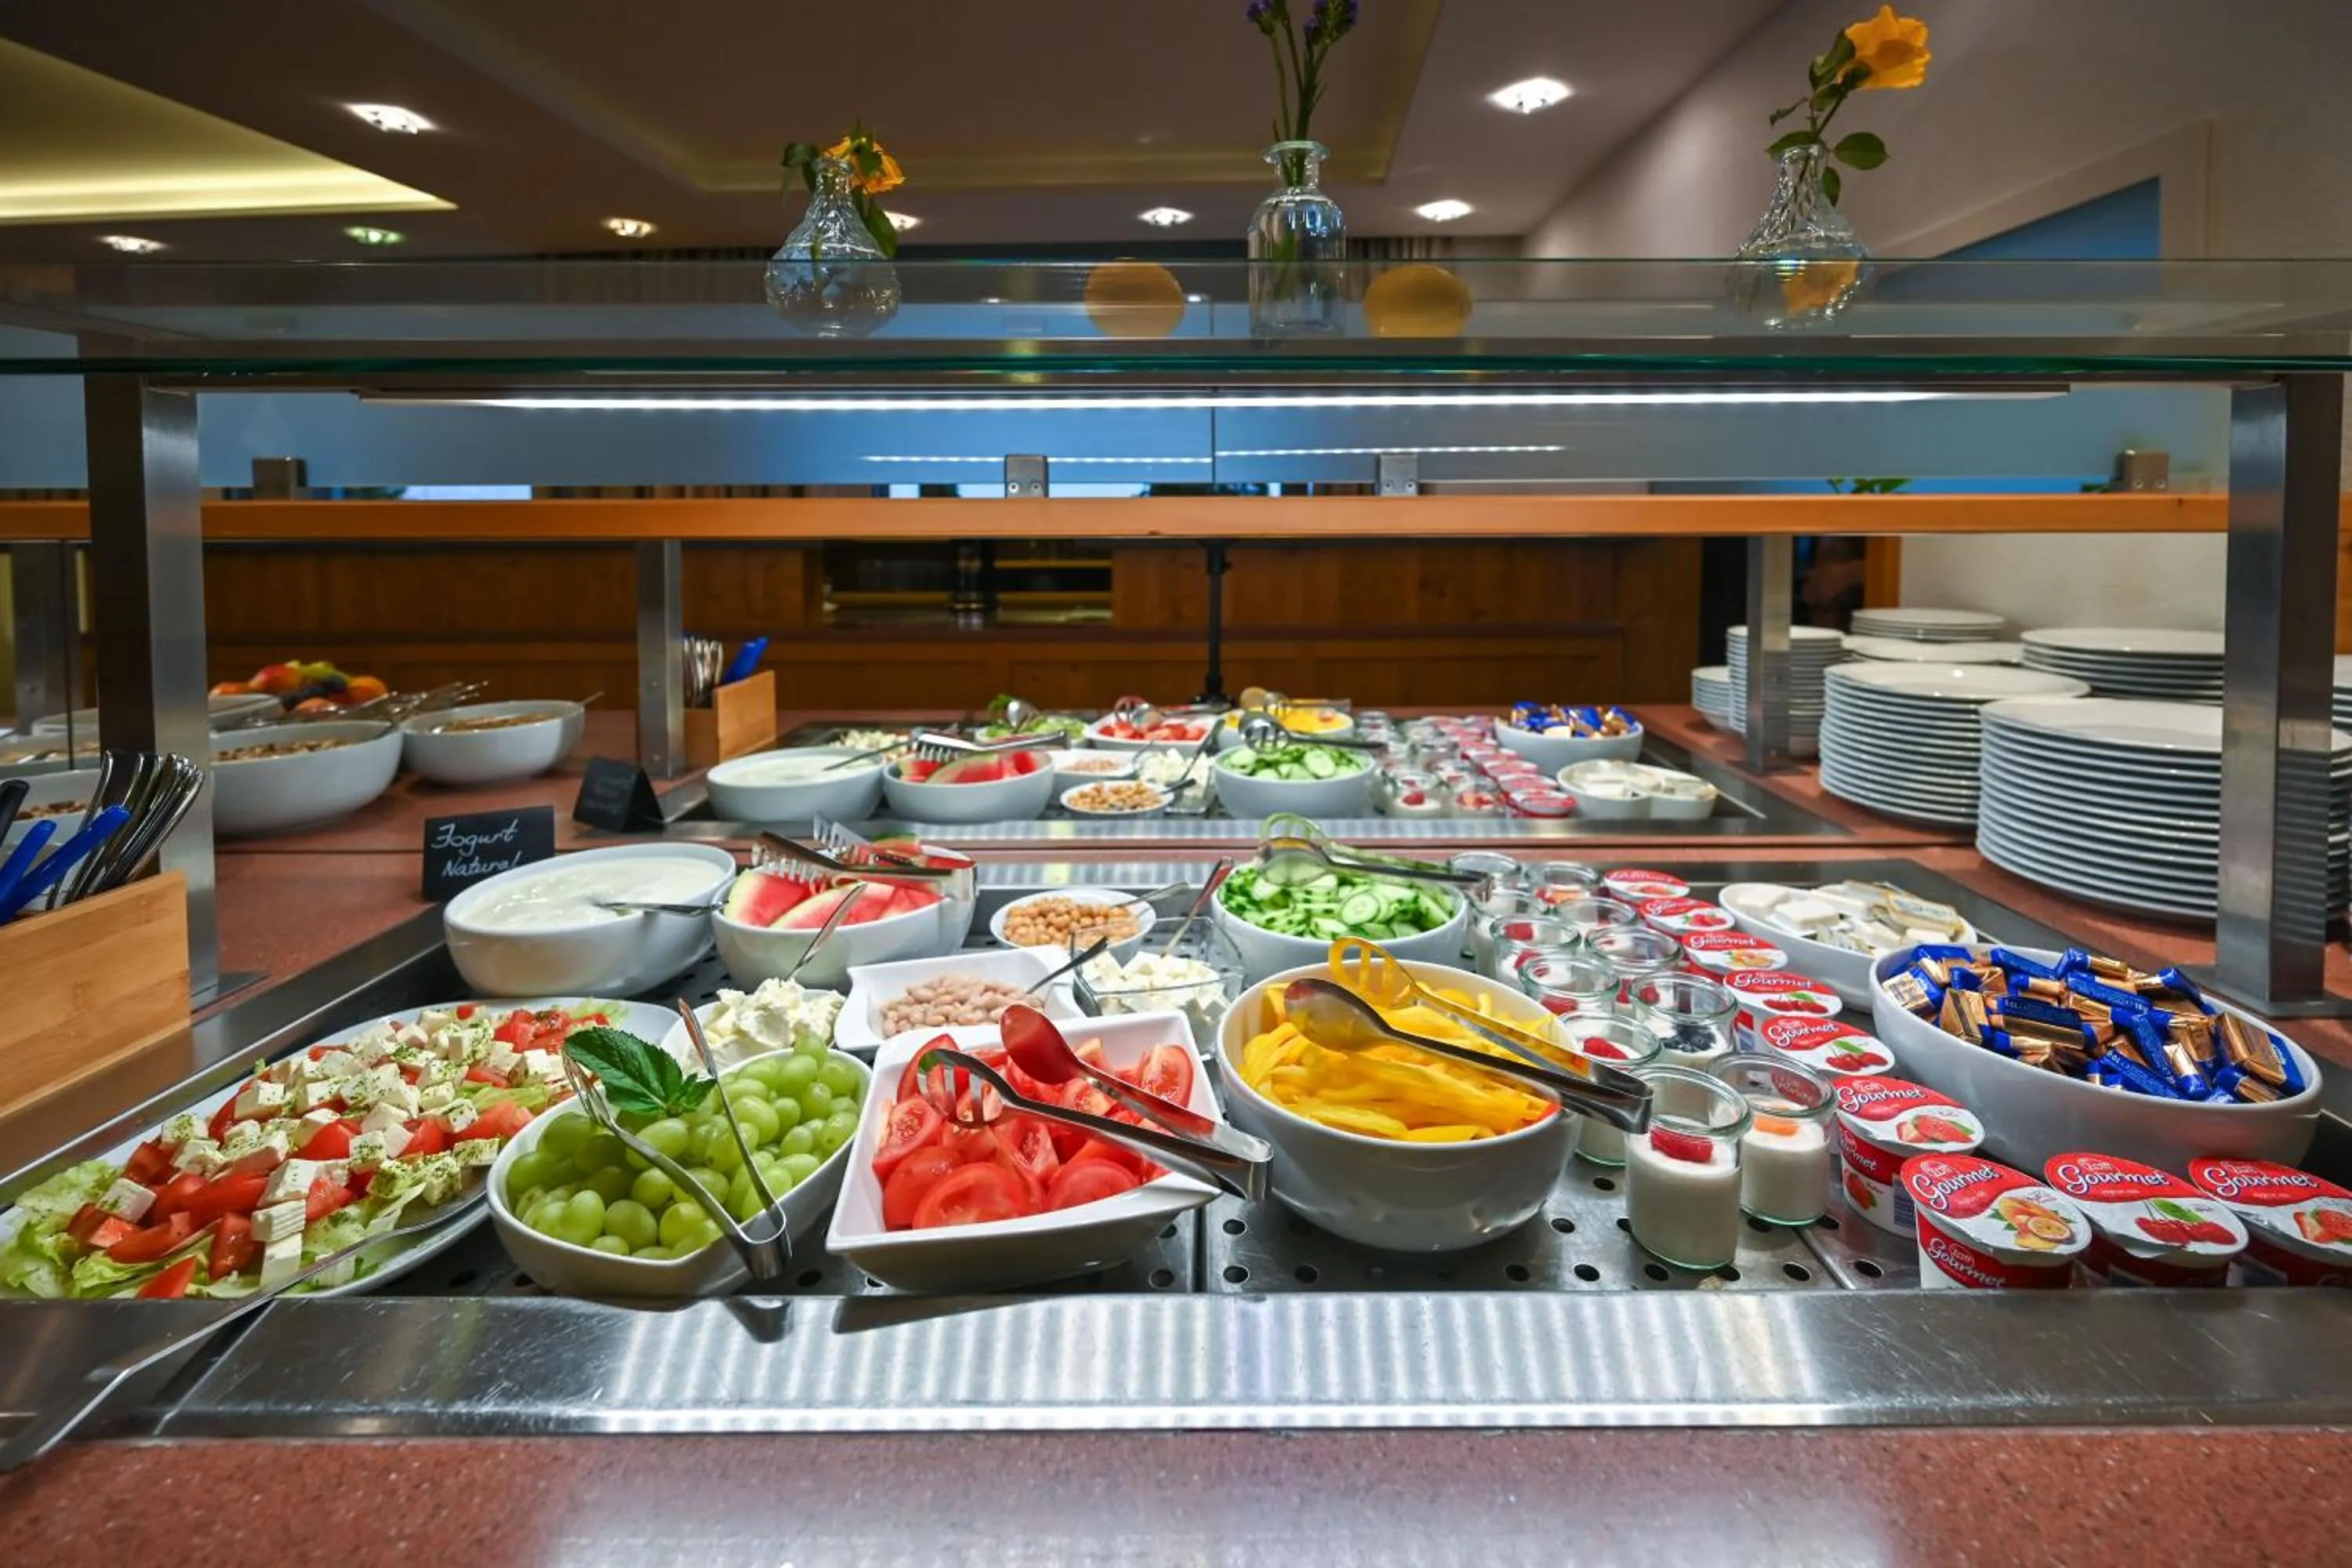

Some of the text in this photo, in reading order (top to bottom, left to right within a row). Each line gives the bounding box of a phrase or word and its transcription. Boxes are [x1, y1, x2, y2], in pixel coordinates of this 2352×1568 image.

[441, 850, 523, 877] Natural
[1734, 973, 1813, 988] Gourmet
[1768, 1022, 1840, 1047] Gourmet
[1837, 1085, 1927, 1112] Gourmet
[1912, 1163, 2001, 1210] Gourmet
[2056, 1163, 2172, 1194] Gourmet
[2204, 1166, 2320, 1197] Gourmet
[1926, 1237, 2006, 1287] Gourmet
